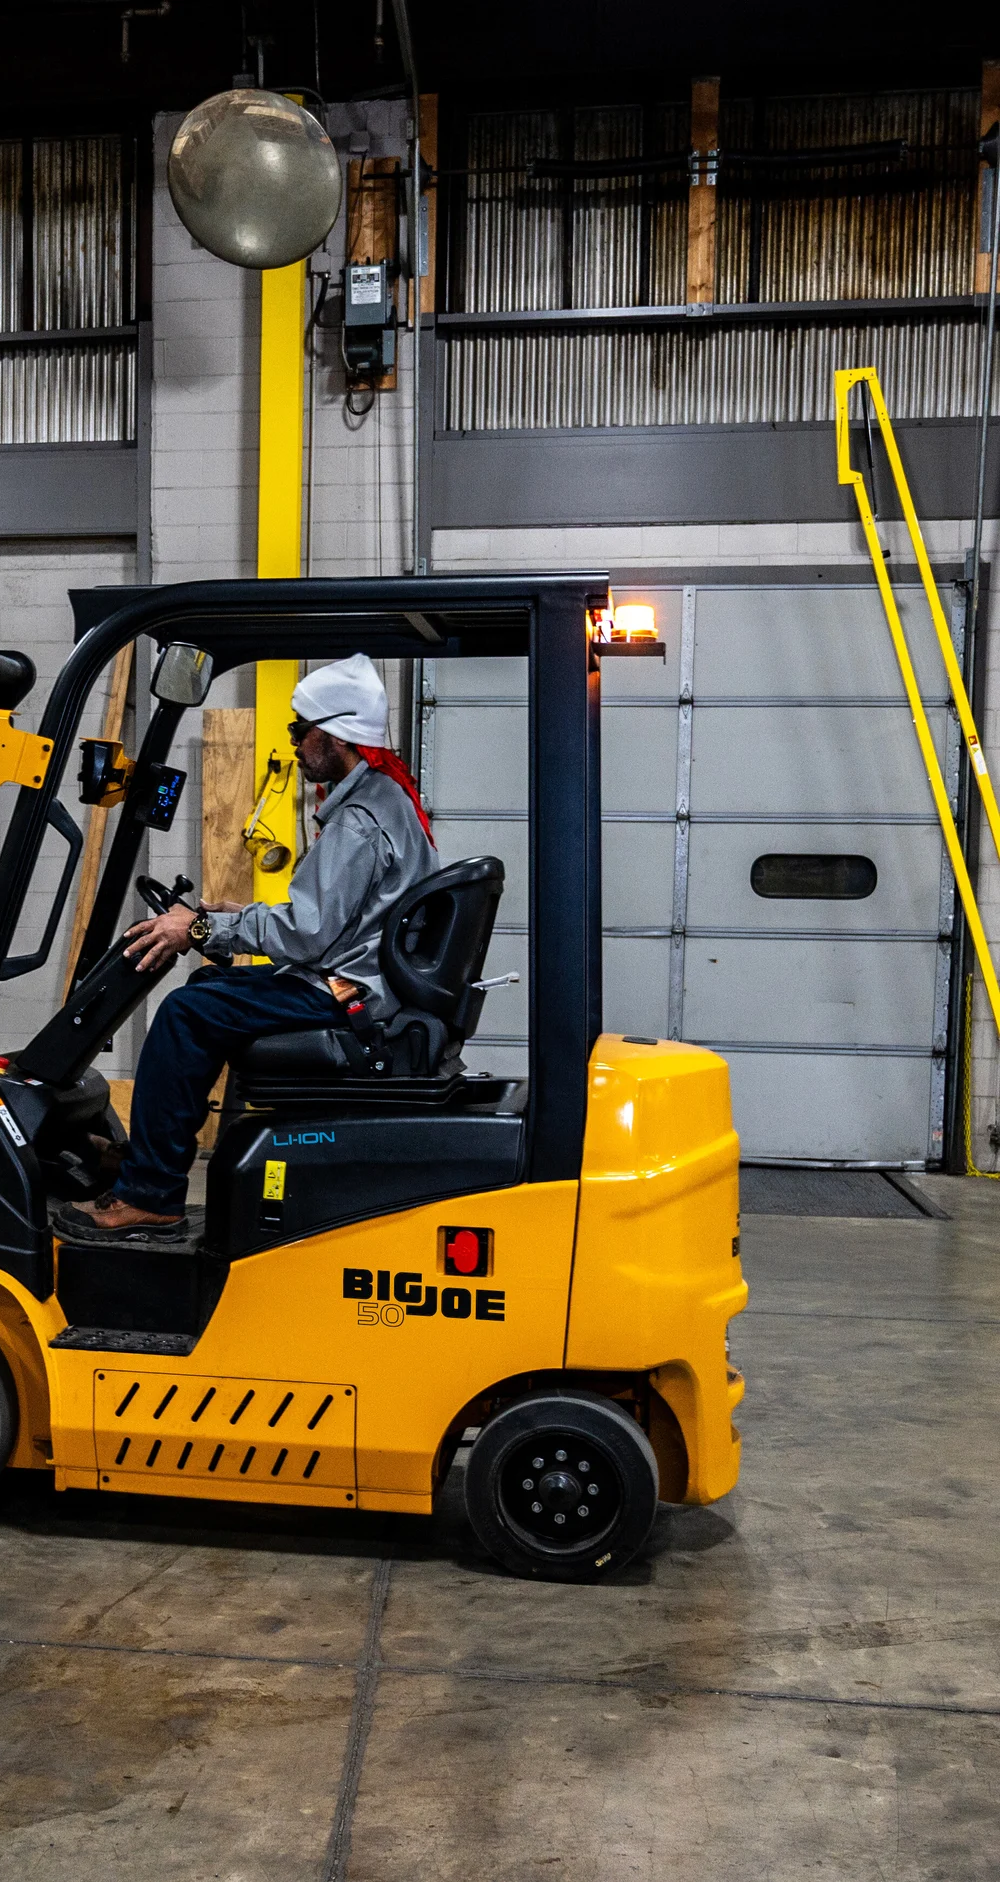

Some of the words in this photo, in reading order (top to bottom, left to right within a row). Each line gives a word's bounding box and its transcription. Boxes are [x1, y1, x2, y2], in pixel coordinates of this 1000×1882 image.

[273, 1131, 335, 1146] LI-ION
[343, 1267, 423, 1304] BIG
[406, 1286, 506, 1322] JOE
[357, 1302, 405, 1328] 50
